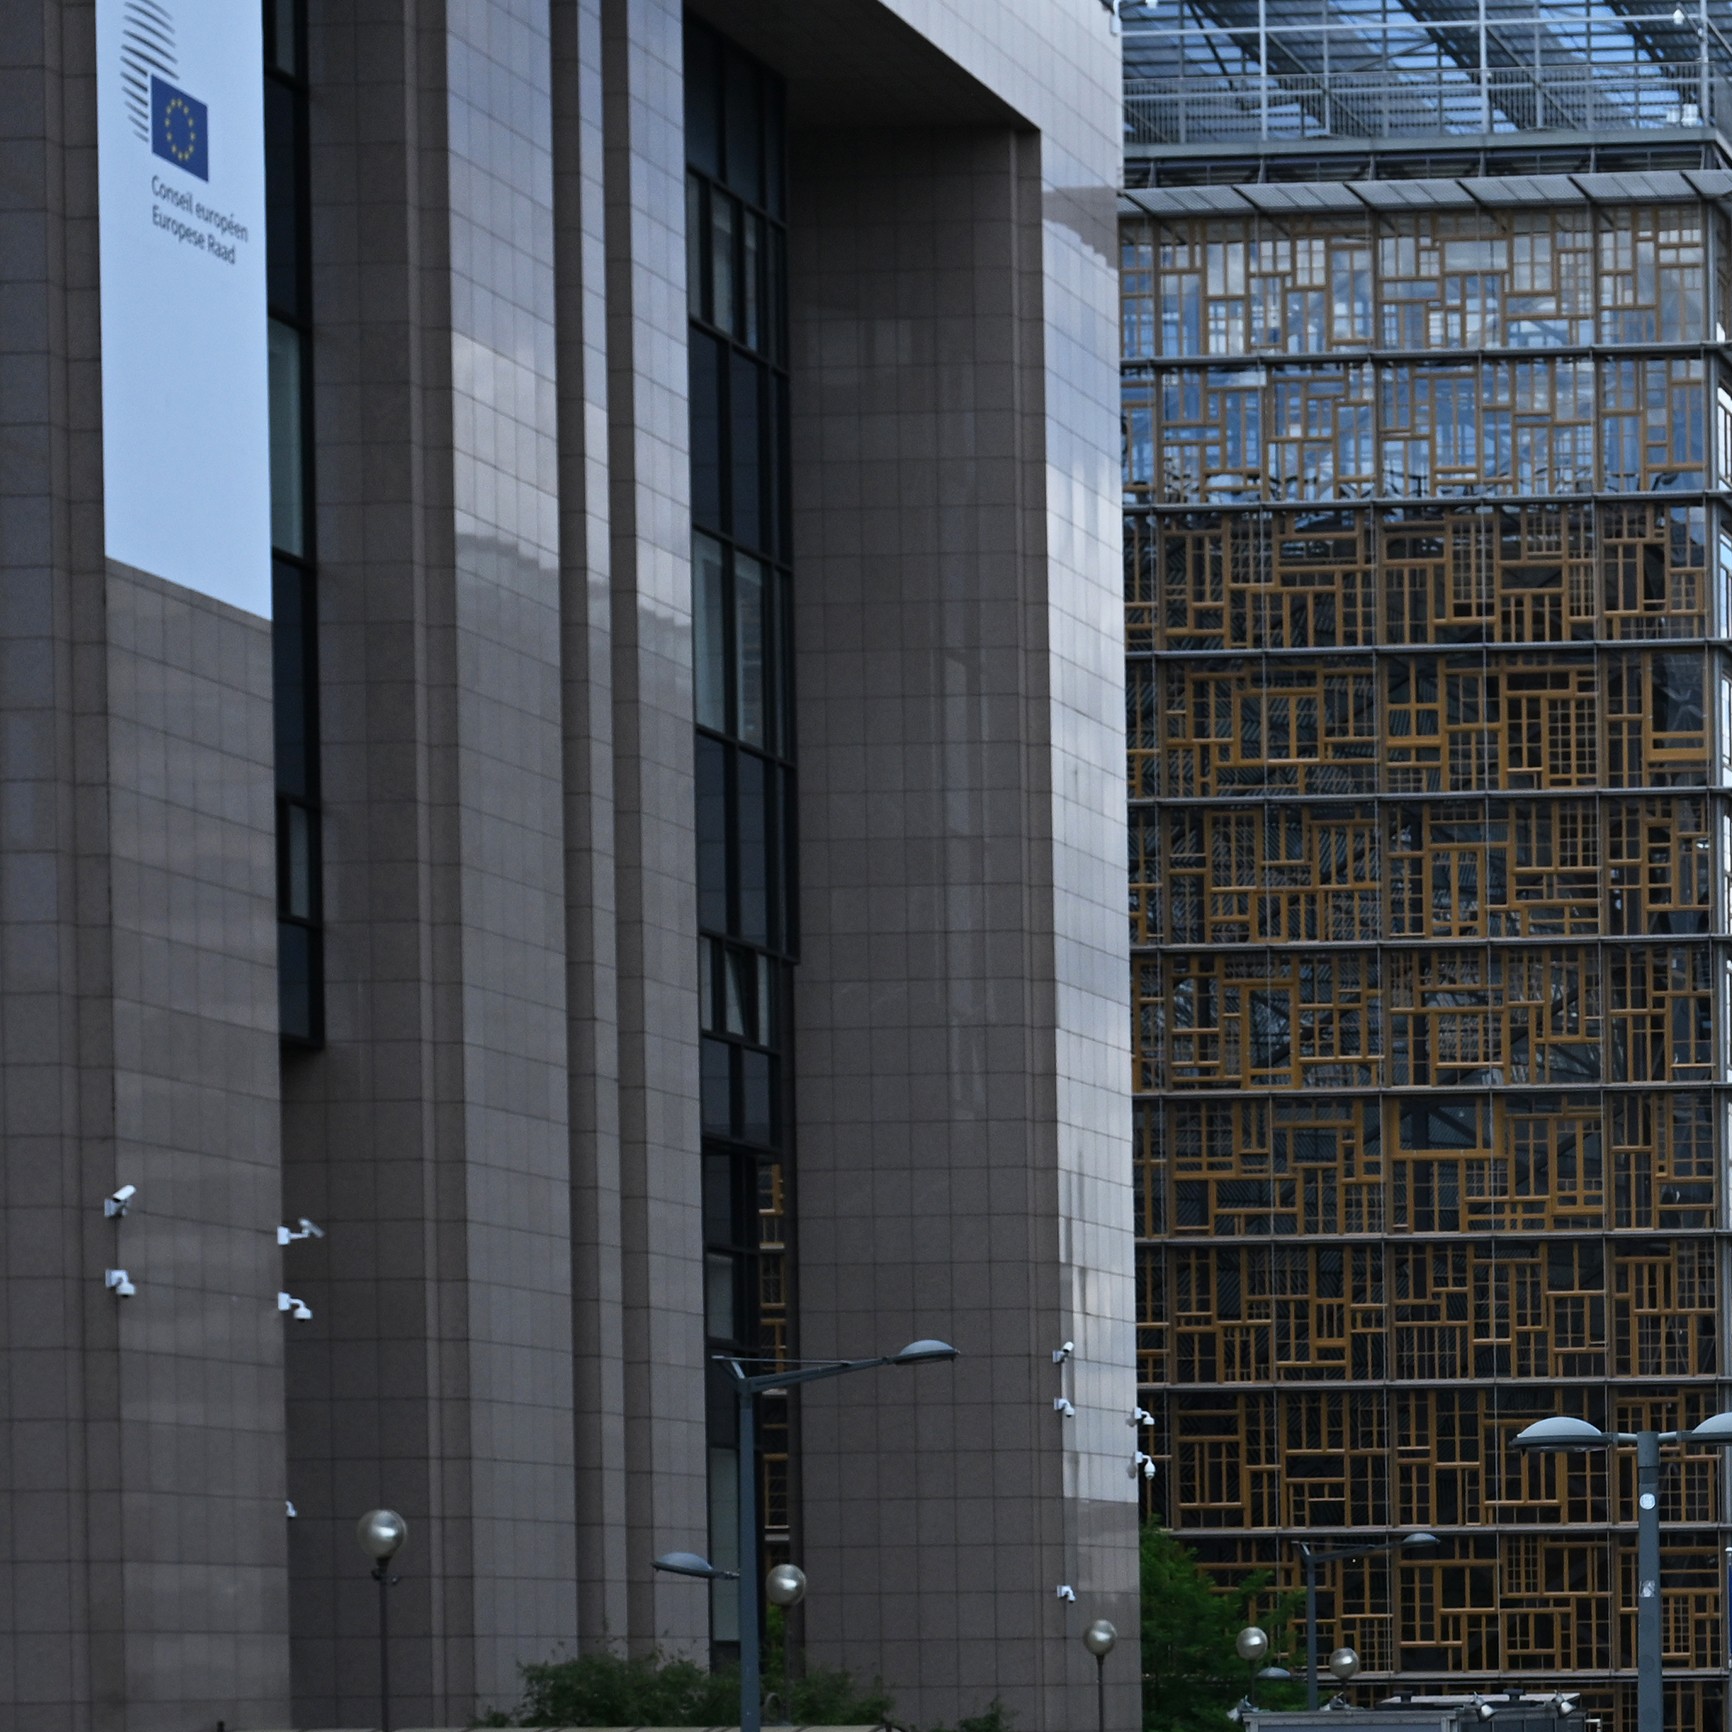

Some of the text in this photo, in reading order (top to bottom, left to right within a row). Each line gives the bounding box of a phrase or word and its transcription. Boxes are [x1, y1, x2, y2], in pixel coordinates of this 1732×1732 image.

[152, 175, 248, 242] Conseil européen
[152, 204, 235, 264] Europese Raad
